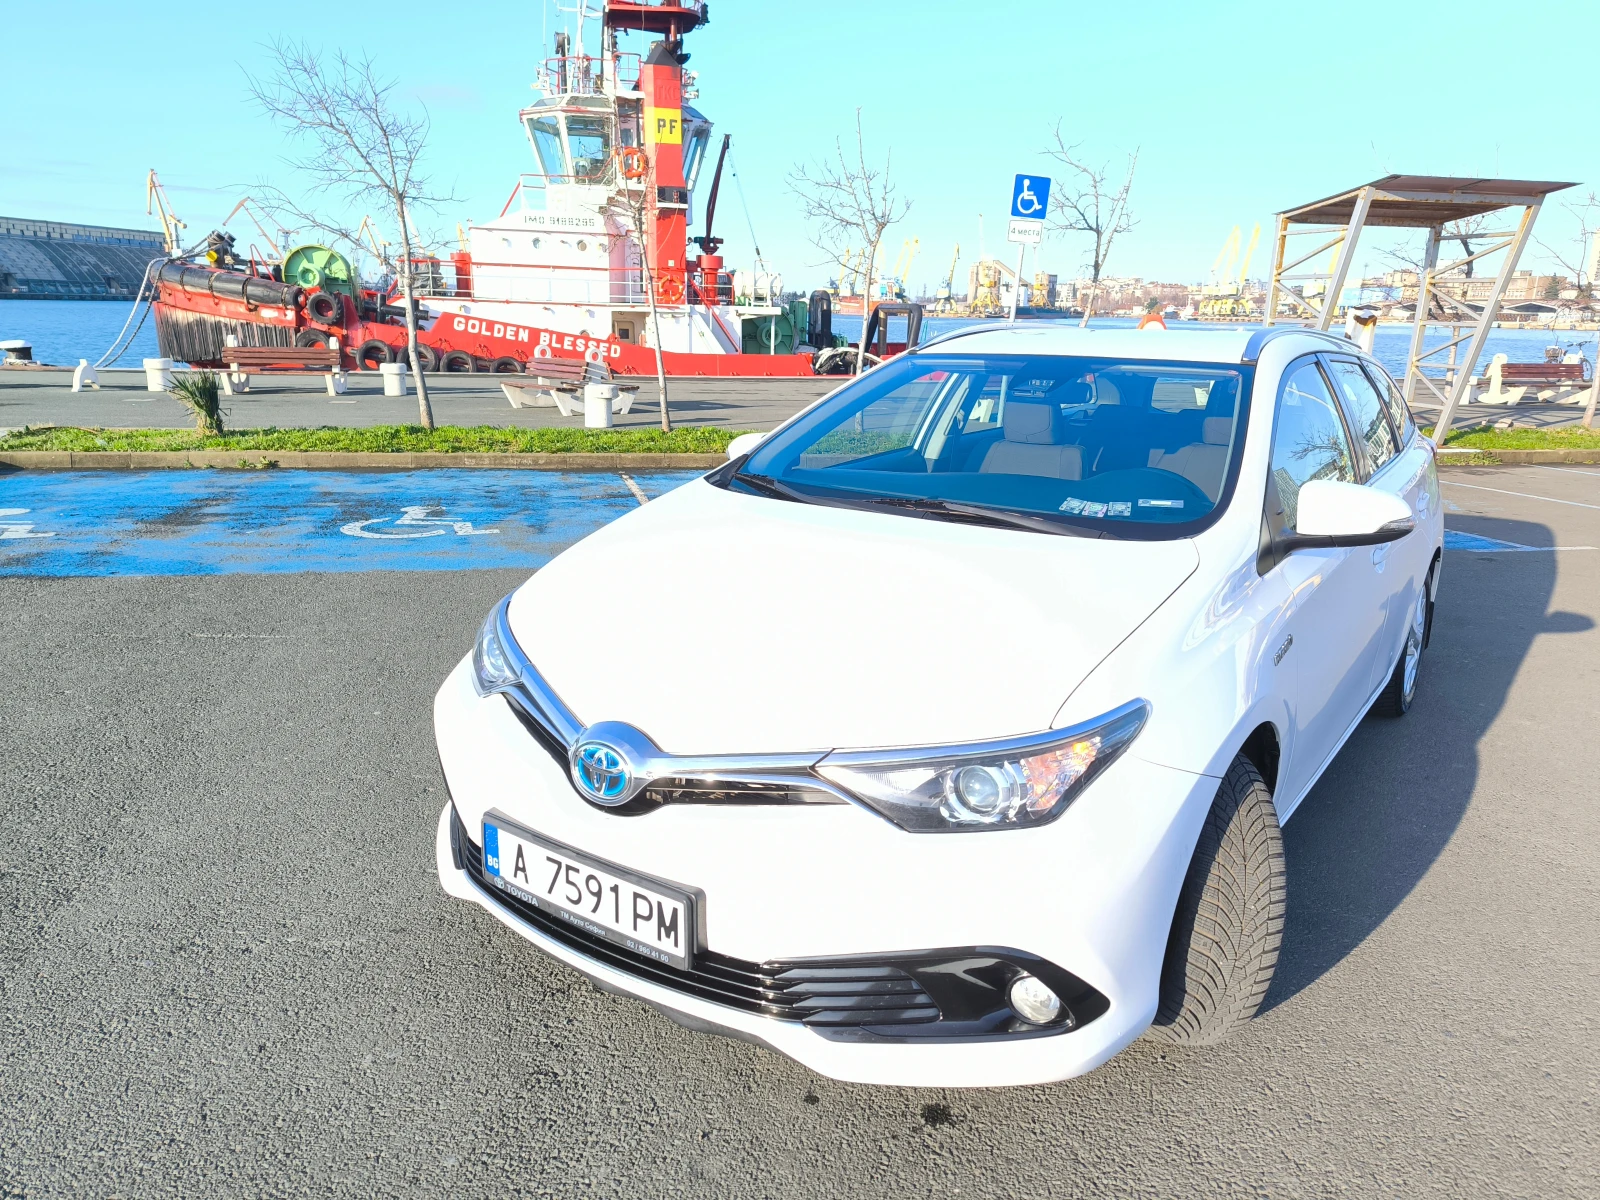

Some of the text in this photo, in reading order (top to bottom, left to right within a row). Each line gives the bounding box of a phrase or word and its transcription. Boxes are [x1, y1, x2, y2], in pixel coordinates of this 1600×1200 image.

[657, 118, 678, 134] PF
[524, 216, 545, 225] IMO
[453, 317, 621, 358] GOLDEN BLESSED
[487, 854, 499, 869] BG
[513, 843, 529, 884] A
[546, 856, 619, 924] 7591
[506, 885, 539, 907] TOYOTA
